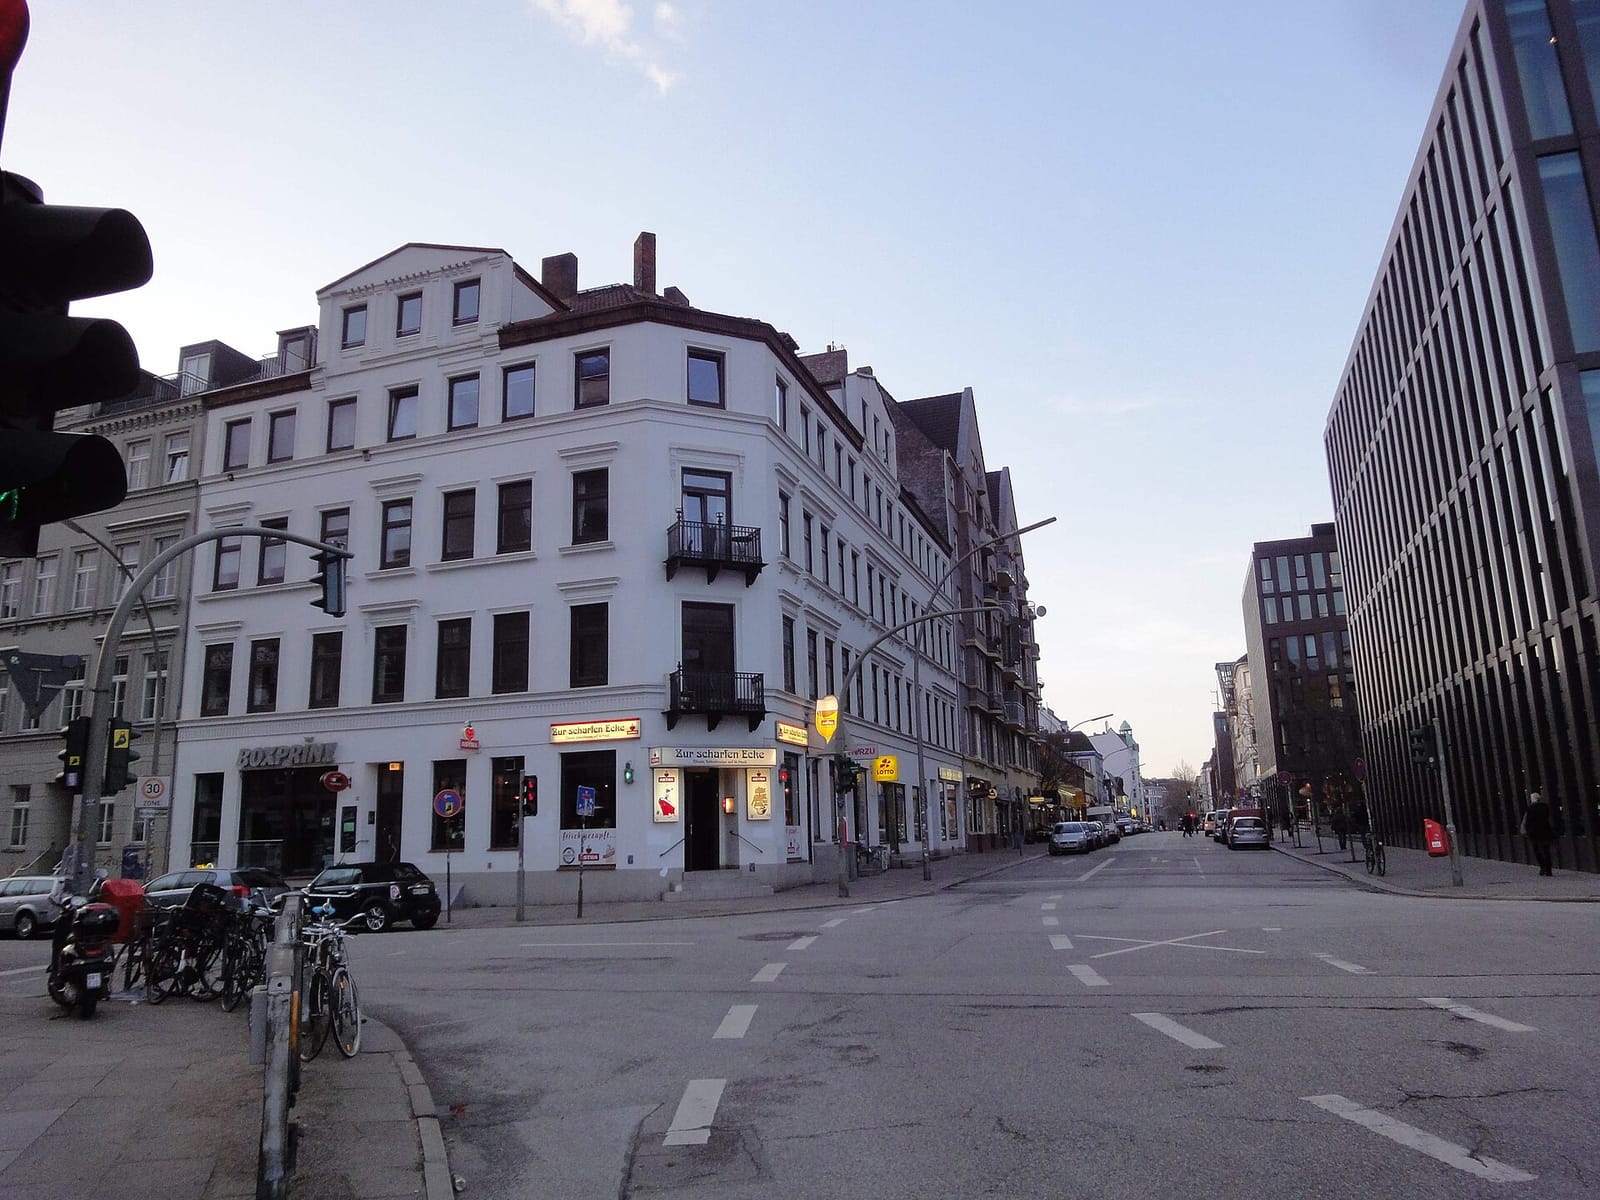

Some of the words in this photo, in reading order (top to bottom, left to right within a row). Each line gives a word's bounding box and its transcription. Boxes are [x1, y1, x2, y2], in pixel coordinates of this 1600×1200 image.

[552, 727, 567, 736] Zur
[568, 725, 603, 736] scharfen
[605, 724, 625, 734] Ecke
[675, 749, 694, 759] Zur
[696, 749, 739, 759] scharfen
[741, 749, 765, 759] Ecke
[146, 783, 160, 794] 30
